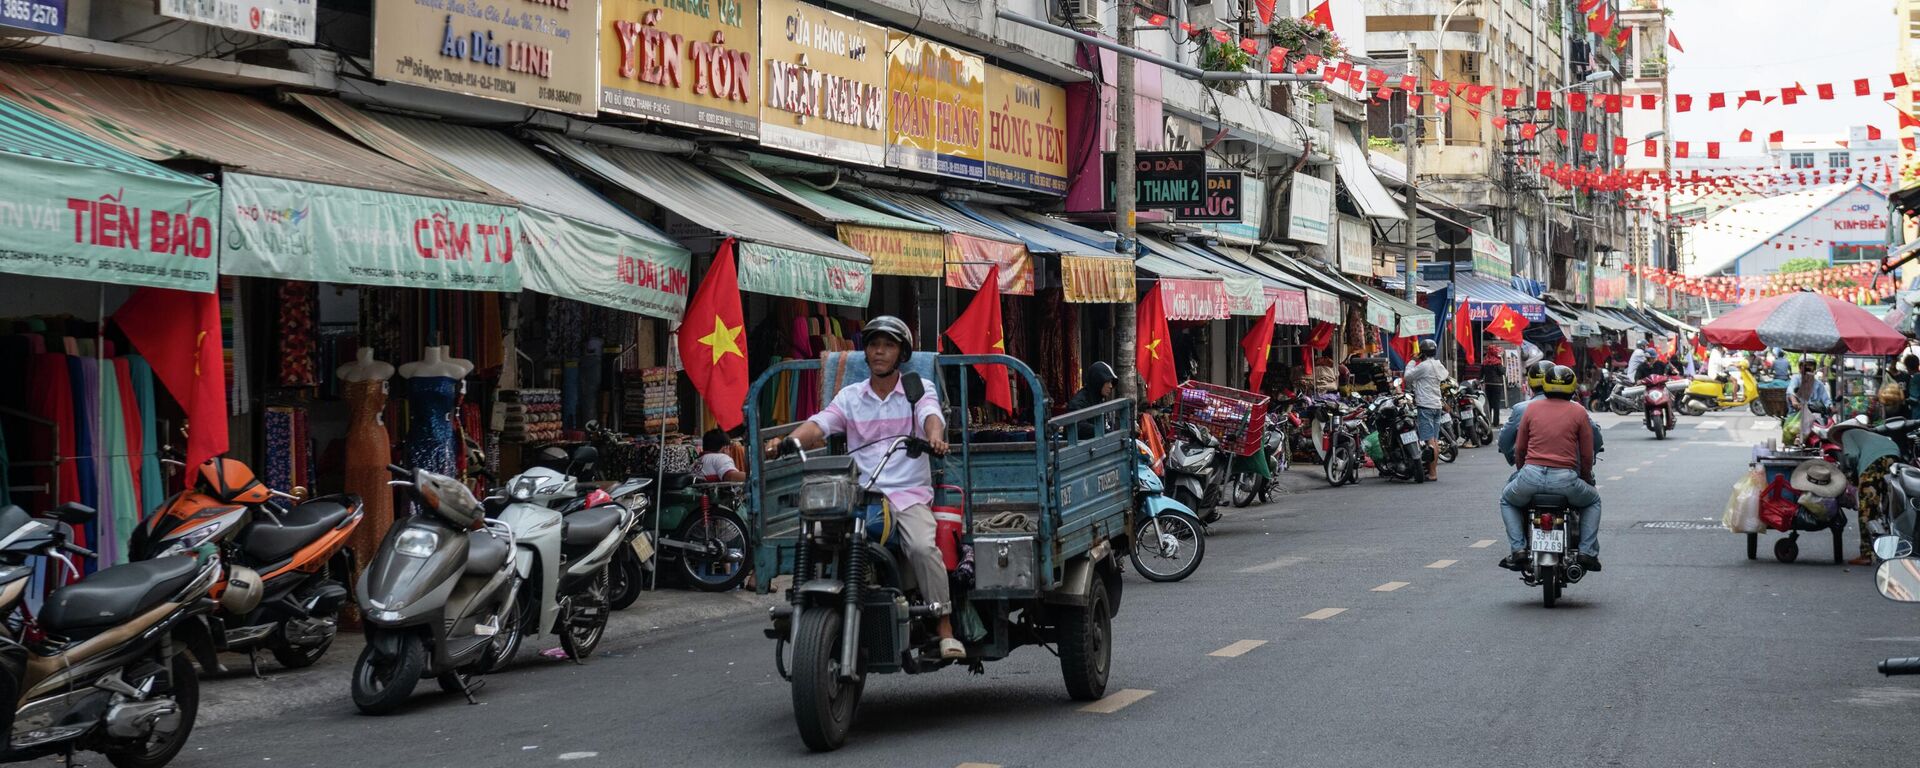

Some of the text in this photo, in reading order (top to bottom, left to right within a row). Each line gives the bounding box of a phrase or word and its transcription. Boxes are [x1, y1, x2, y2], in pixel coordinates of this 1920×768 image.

[4, 0, 58, 26] 3855 2578
[439, 15, 553, 79] Áo Dài LINH
[613, 8, 684, 88] YẾN
[786, 8, 867, 63] CỬA HÀNG VẢI
[604, 91, 613, 104] 70
[768, 52, 822, 126] NHẬT
[821, 73, 863, 126] NAM
[1015, 82, 1041, 110] DNTN
[935, 93, 980, 150] THẮNG
[989, 94, 1032, 158] HỒNG
[1035, 105, 1065, 165] YẾN
[1135, 157, 1183, 171] O DÀI
[1144, 180, 1189, 202] THANH
[1191, 180, 1200, 201] 2
[1208, 177, 1232, 190] DÀI
[66, 187, 140, 250] TIẾN
[150, 198, 212, 259] BẢO
[1834, 220, 1857, 230] KIM
[1851, 204, 1870, 212] CHỢ
[476, 214, 514, 264] TÚ
[637, 253, 658, 291] DÀI
[661, 264, 688, 297] LINH
[1532, 541, 1562, 552] 012.69
